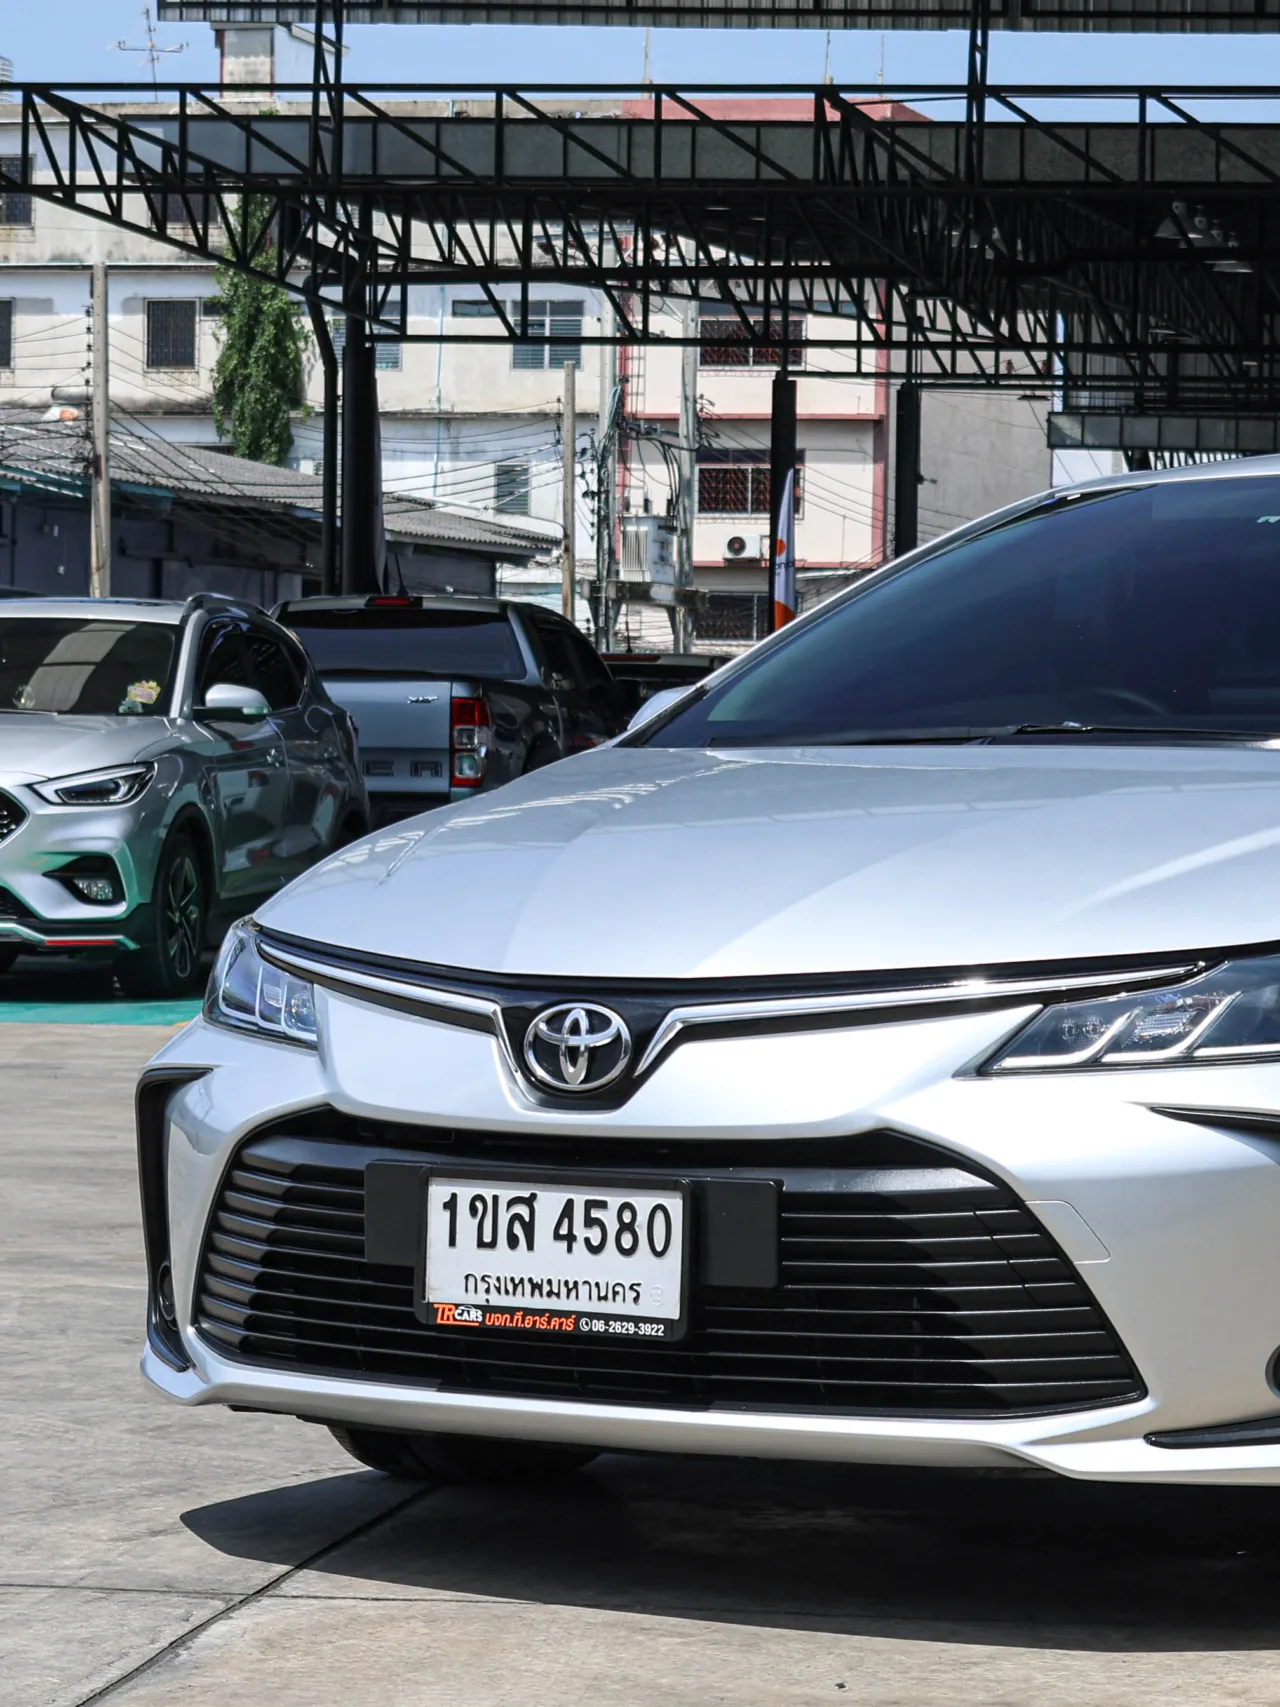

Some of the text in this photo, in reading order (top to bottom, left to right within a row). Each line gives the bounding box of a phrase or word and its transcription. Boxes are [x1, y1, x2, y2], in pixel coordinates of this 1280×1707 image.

[443, 1192, 672, 1258] 1ขส 4580
[464, 1273, 642, 1304] กรุงเทพมหานคร
[592, 1320, 665, 1336] 06-2629-3922
